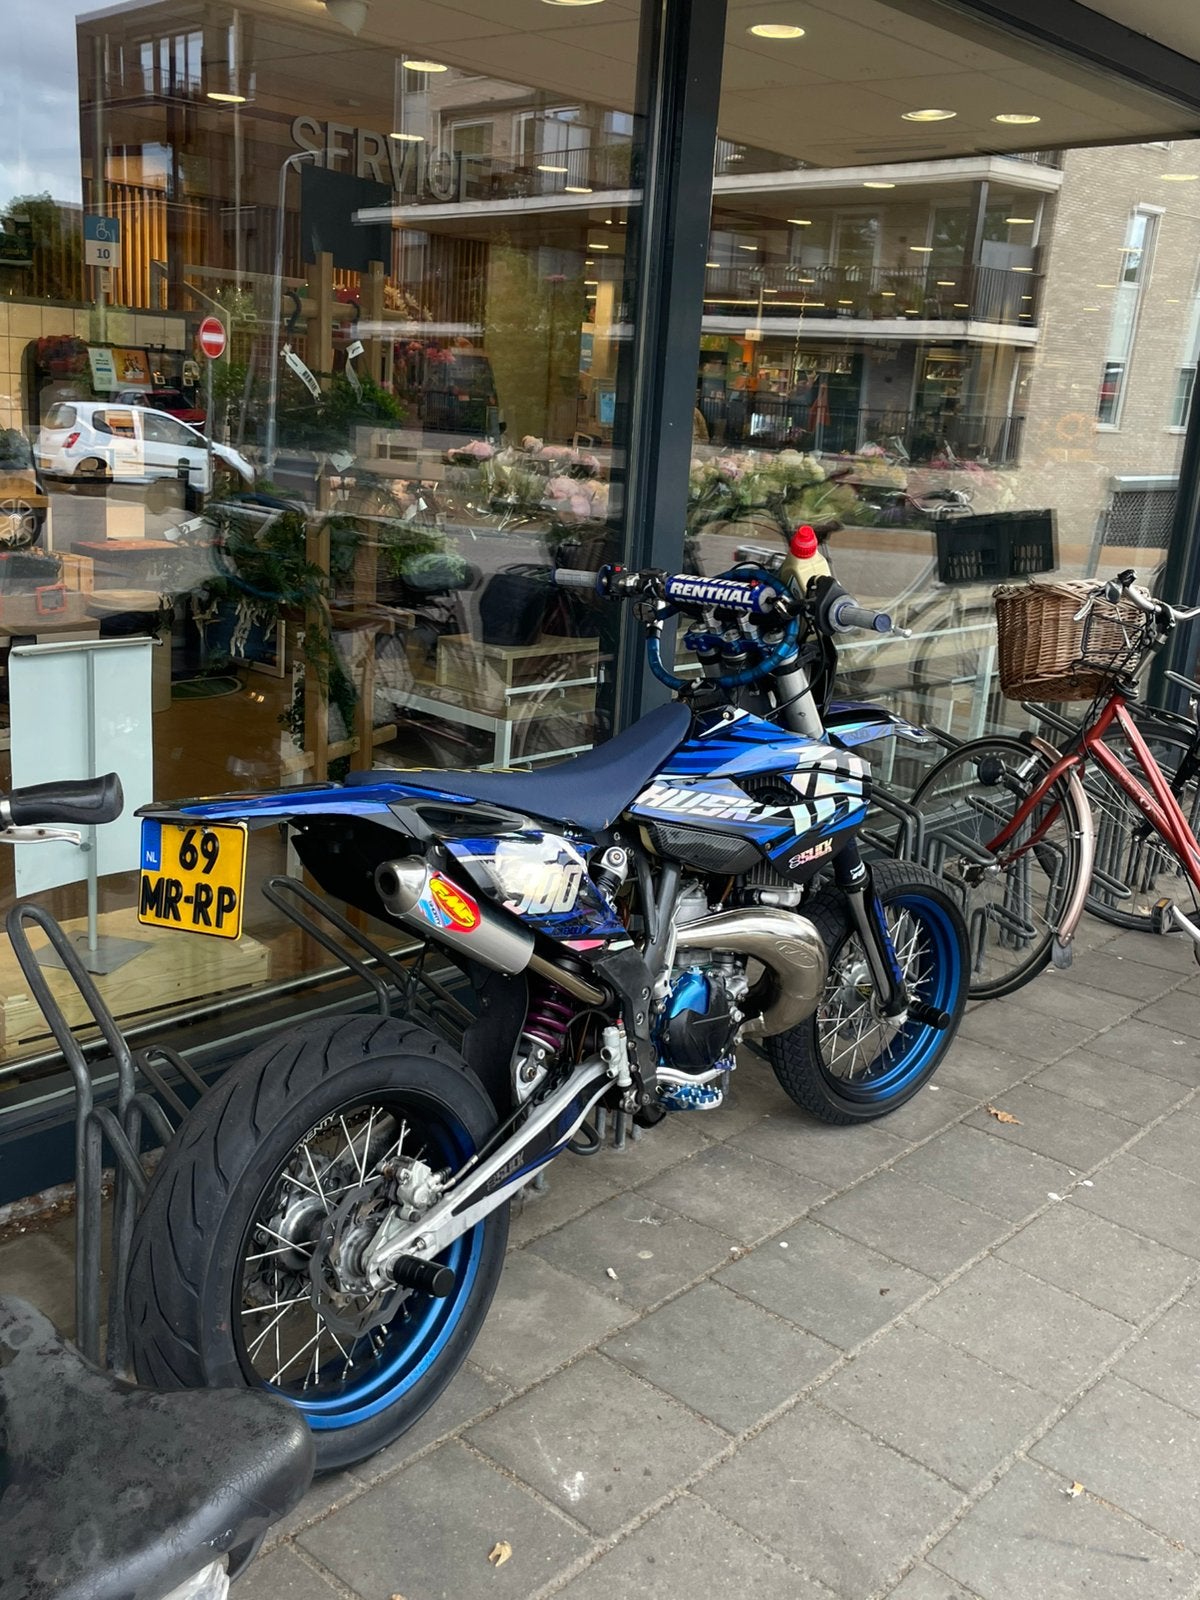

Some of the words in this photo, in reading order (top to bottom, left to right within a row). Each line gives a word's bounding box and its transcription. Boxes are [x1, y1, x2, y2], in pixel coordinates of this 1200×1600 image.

[290, 115, 482, 202] SERVICE
[96, 248, 111, 260] 10
[669, 582, 754, 605] RENTHAL
[635, 785, 790, 823] HUSKY
[145, 850, 158, 863] NL
[178, 829, 220, 875] 69
[140, 875, 237, 929] MR-RP
[430, 879, 476, 924] FMF
